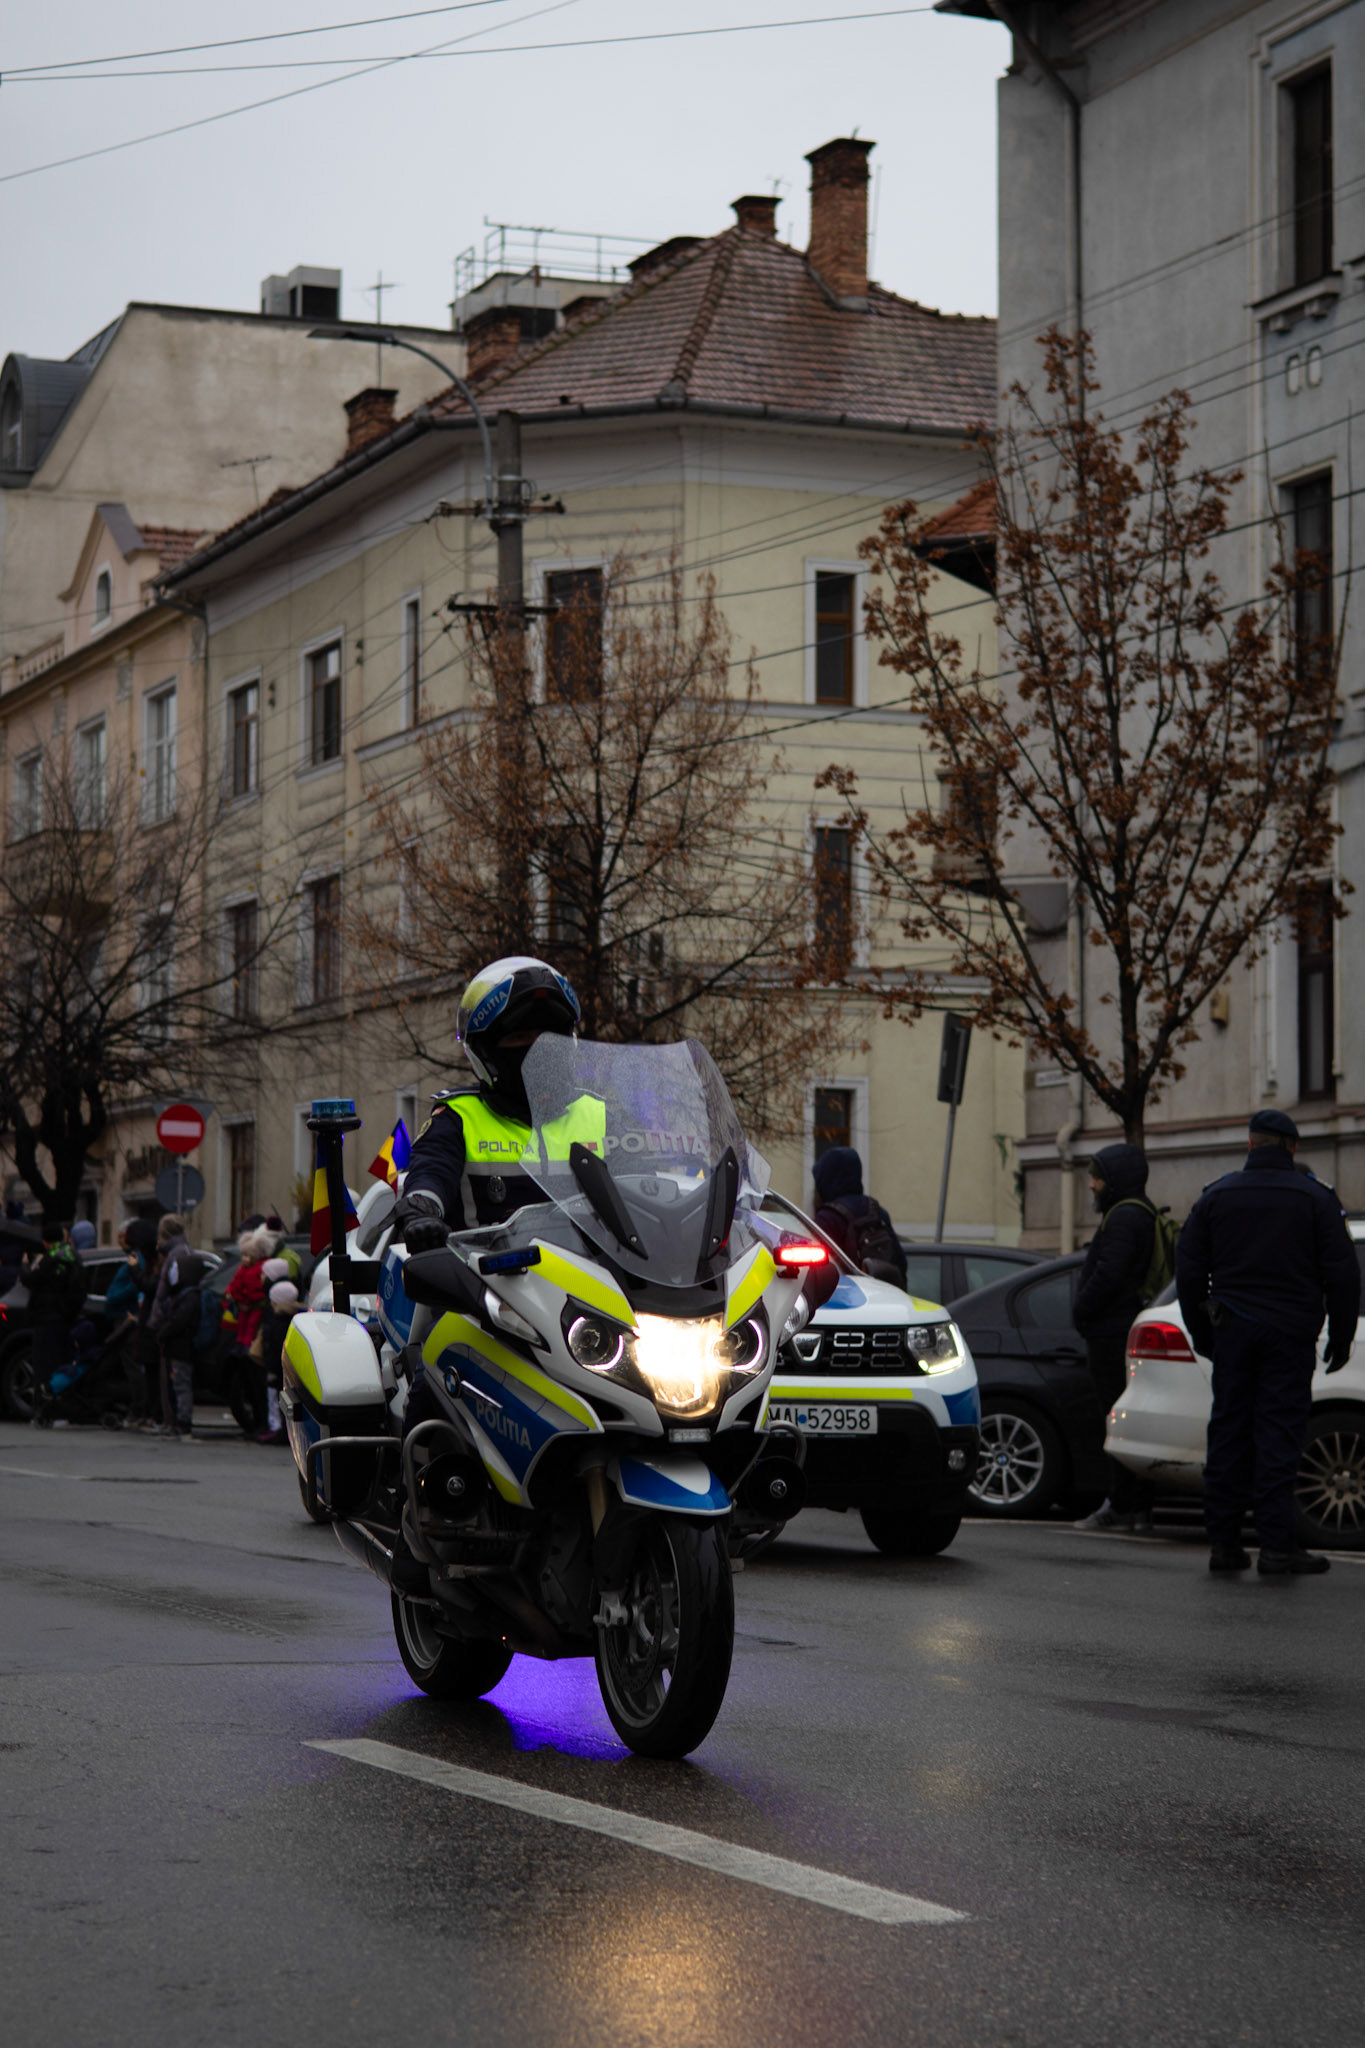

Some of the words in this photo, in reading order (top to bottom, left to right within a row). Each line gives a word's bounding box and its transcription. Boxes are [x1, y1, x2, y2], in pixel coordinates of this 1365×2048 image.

[473, 990, 508, 1027] POLITIA
[602, 1132, 711, 1160] POLITIA
[476, 1398, 533, 1452] POLITIA
[808, 1407, 871, 1431] 52958
